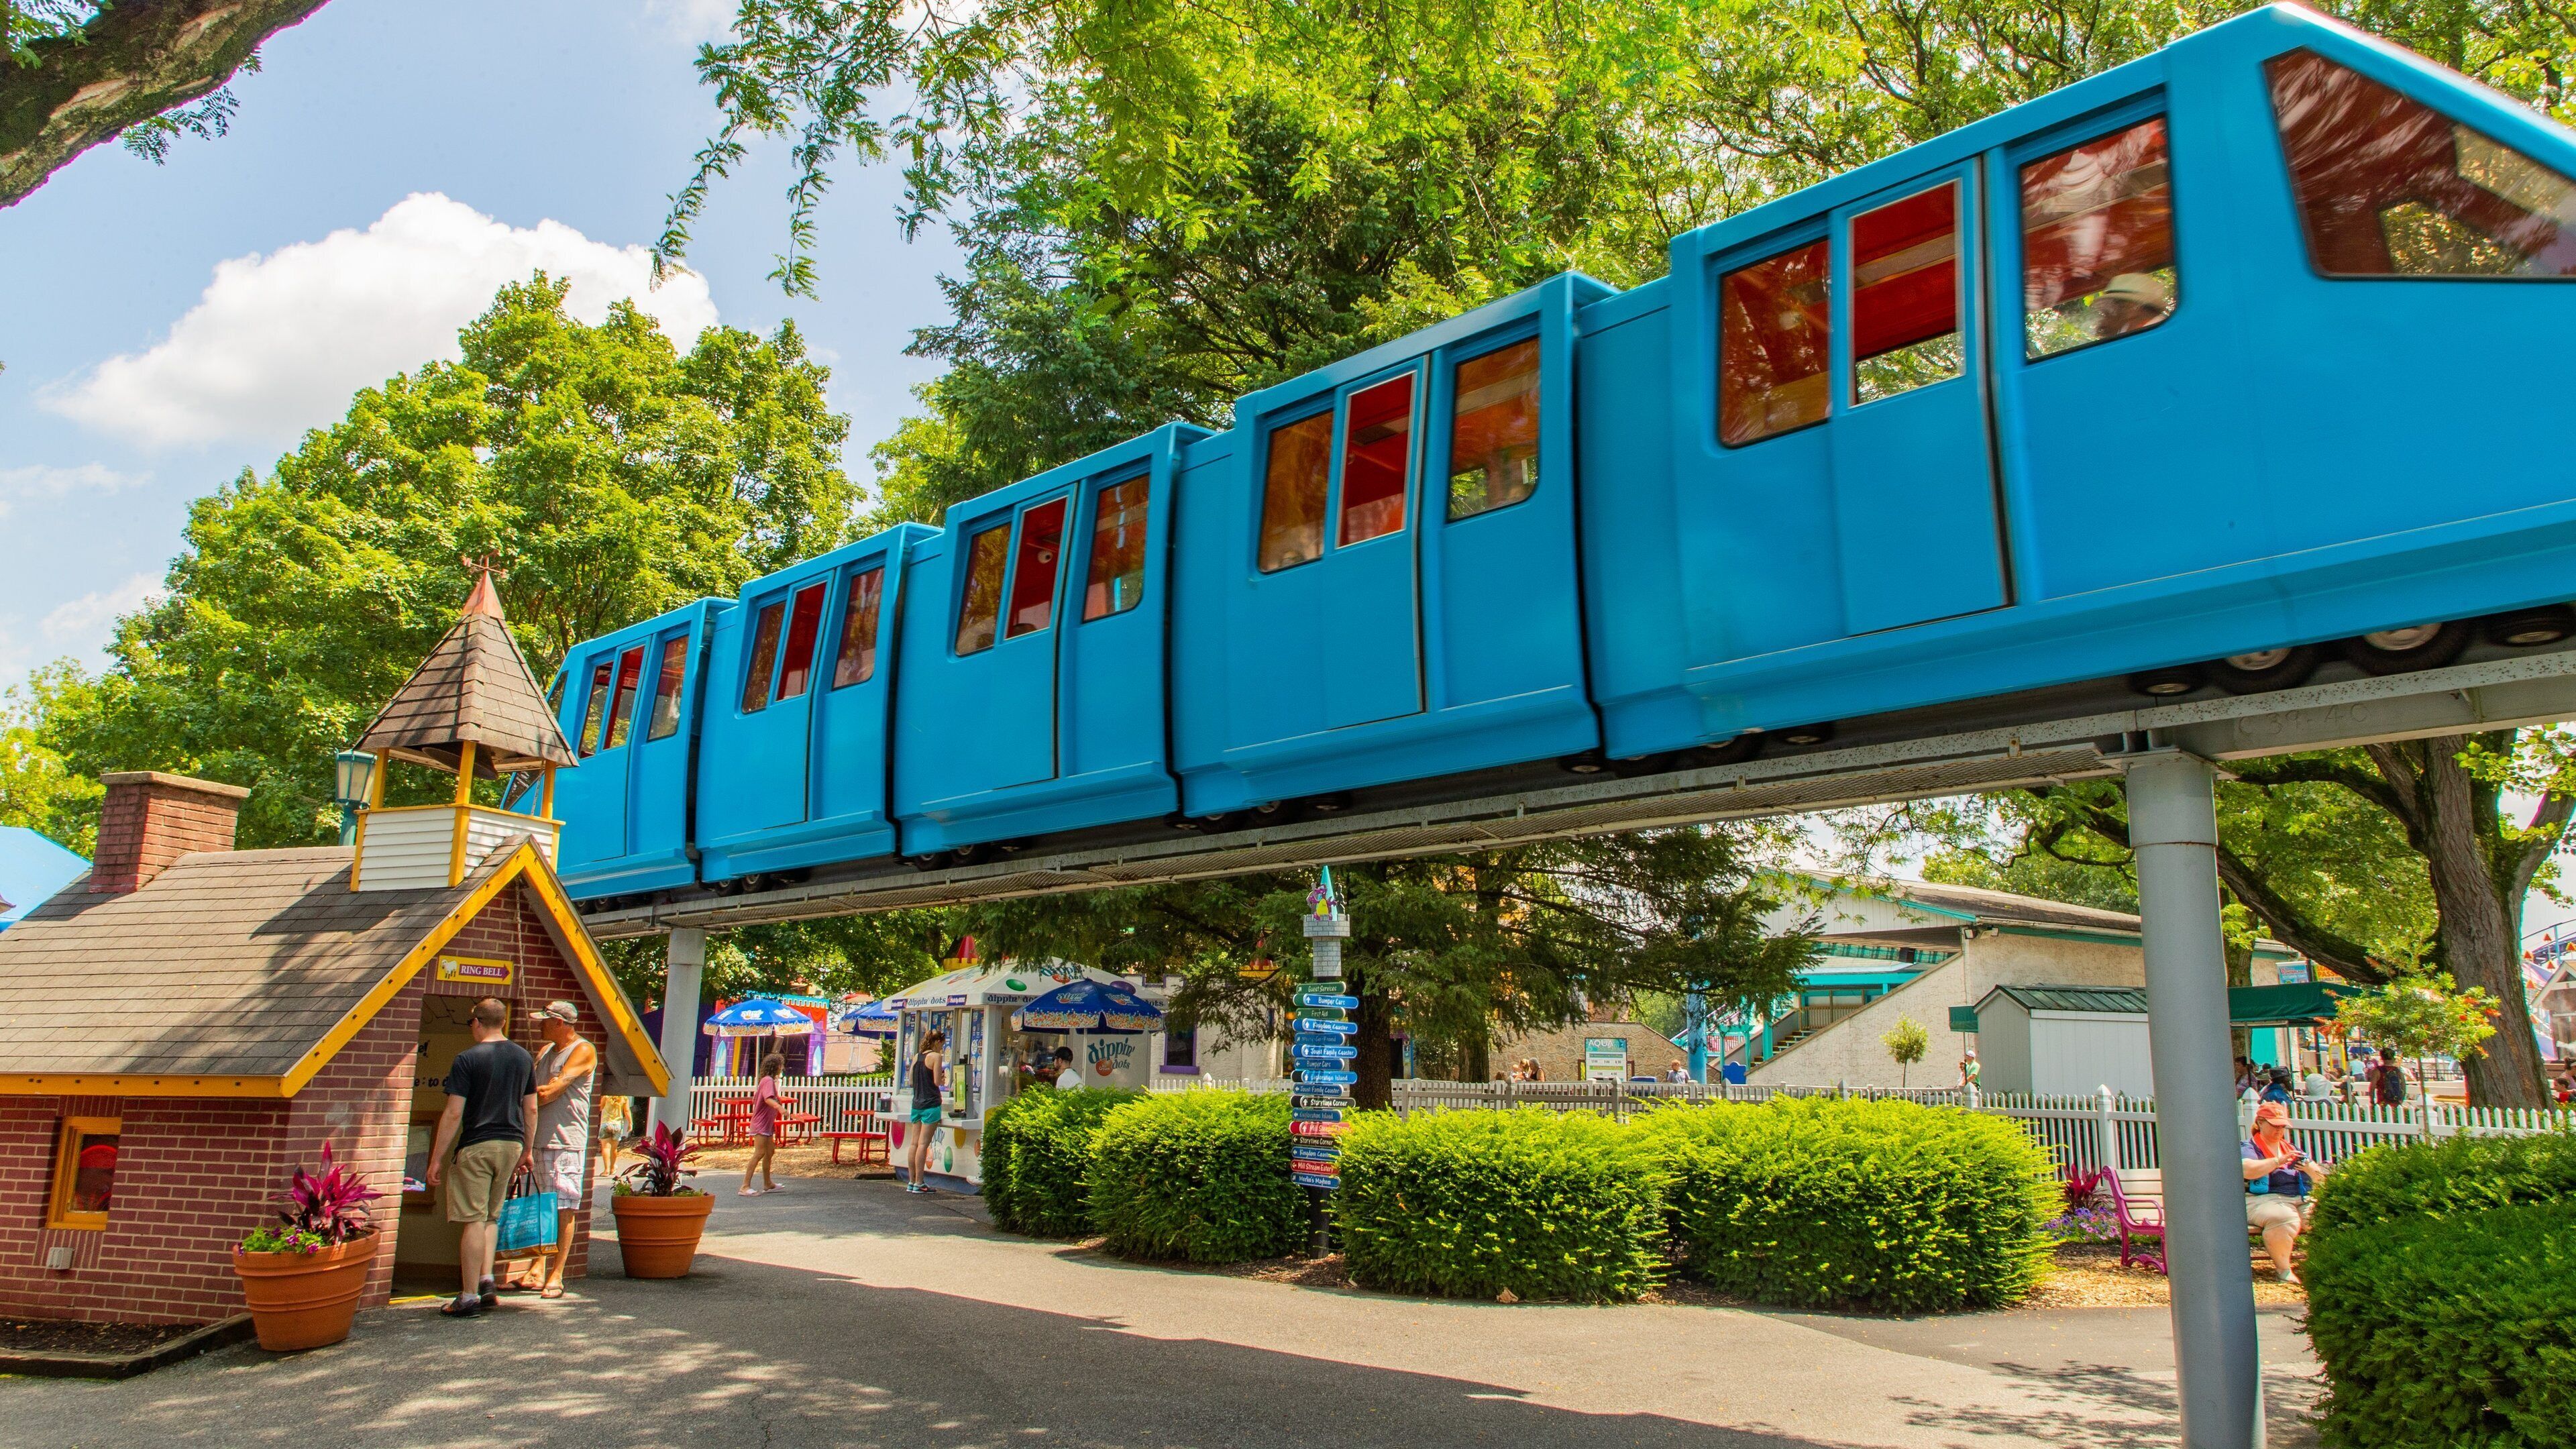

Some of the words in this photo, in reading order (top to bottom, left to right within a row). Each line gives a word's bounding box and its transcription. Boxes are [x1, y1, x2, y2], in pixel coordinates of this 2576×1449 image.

[461, 965, 482, 975] RING
[483, 967, 502, 977] BELL
[931, 997, 947, 1005] dots
[987, 995, 1020, 1004] dippin'
[1318, 997, 1334, 1006] Bumper
[1336, 998, 1345, 1006] Cars
[1589, 1040, 1613, 1048] AQUA
[1087, 1037, 1135, 1063] dippin'
[1324, 1049, 1337, 1057] Family
[1112, 1059, 1130, 1069] dots
[1311, 1086, 1324, 1094] Family
[1311, 1099, 1332, 1107] Storytime
[1299, 1137, 1319, 1145] Storytime
[1320, 1138, 1334, 1146] Corner
[1299, 1149, 1316, 1158] Kingdom
[1305, 1163, 1320, 1171] Stream
[1320, 1165, 1334, 1173] Eatery
[1315, 1177, 1331, 1186] Mayhem
